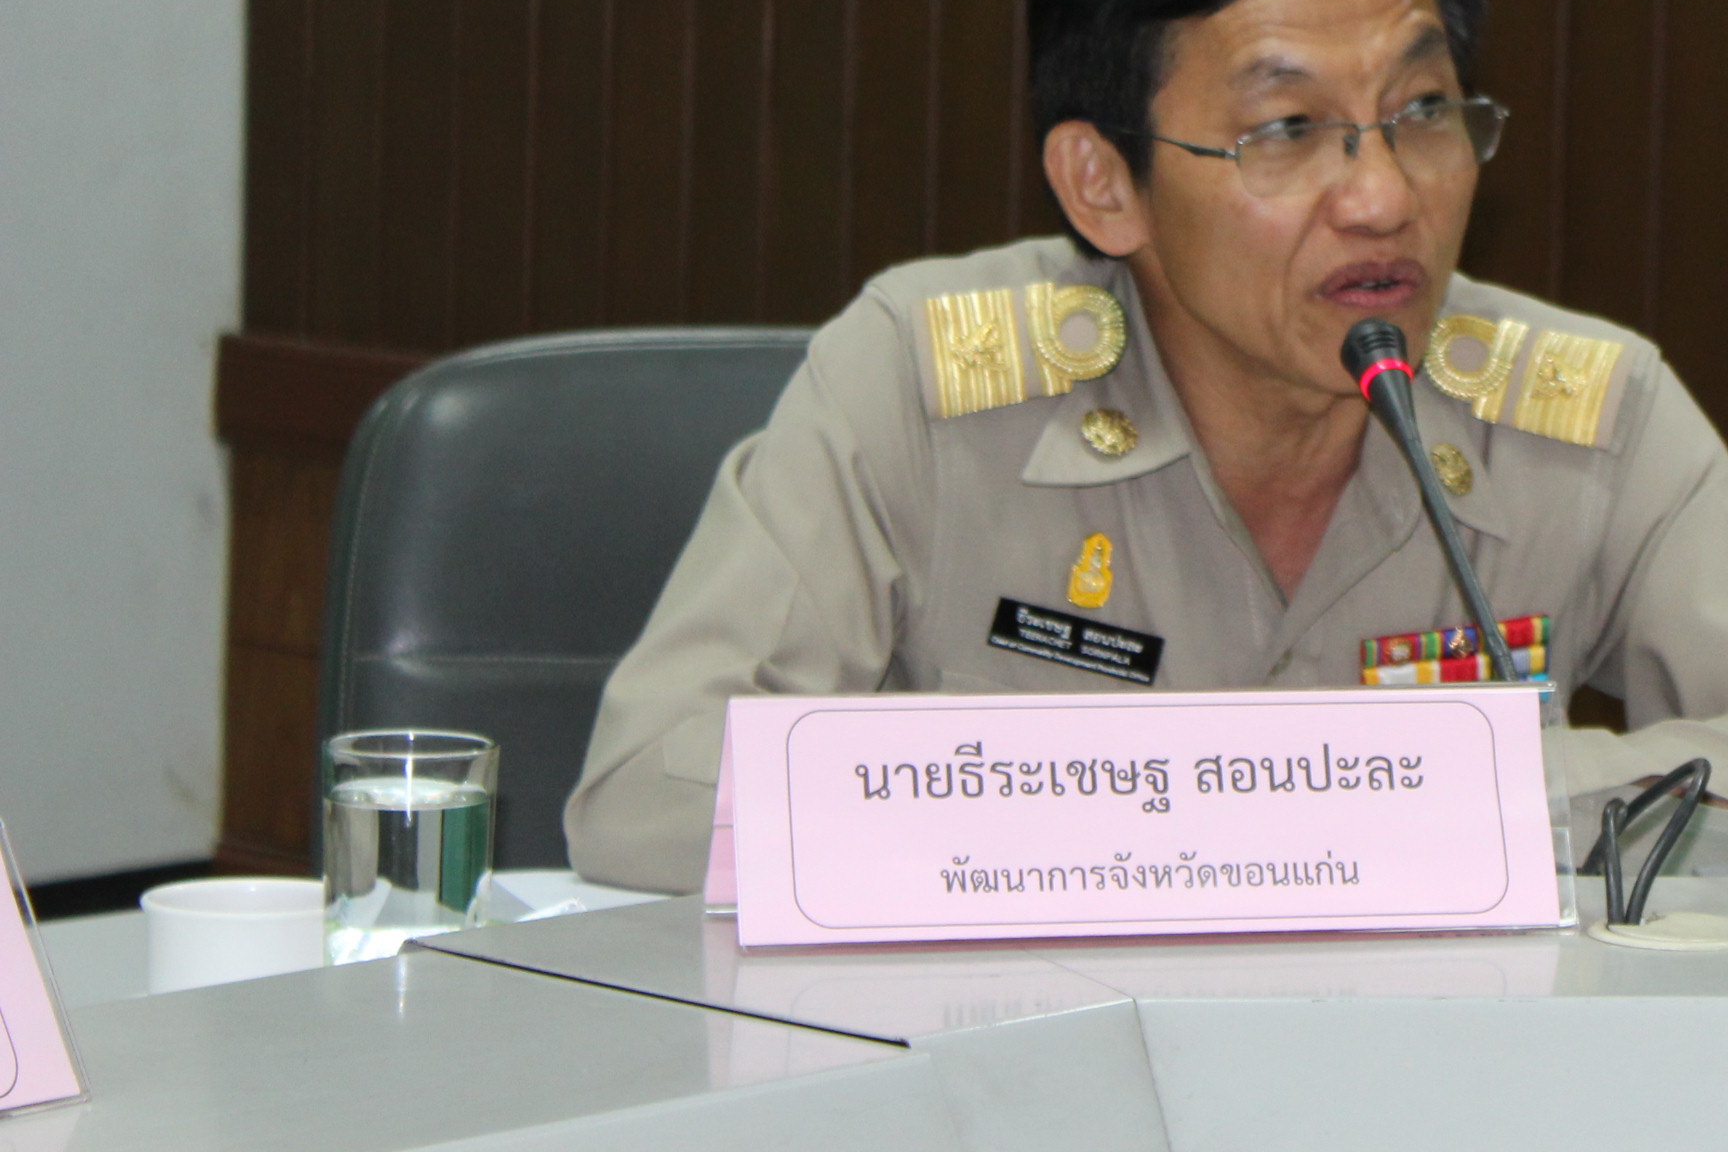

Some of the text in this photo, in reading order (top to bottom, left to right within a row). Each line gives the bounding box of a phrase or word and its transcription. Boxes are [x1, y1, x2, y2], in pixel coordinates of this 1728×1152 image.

[854, 740, 1424, 814] นายธีระเชษฐ สอนปะละ
[940, 850, 1360, 893] พัฒนาการจังหวัดขอนแก่น
